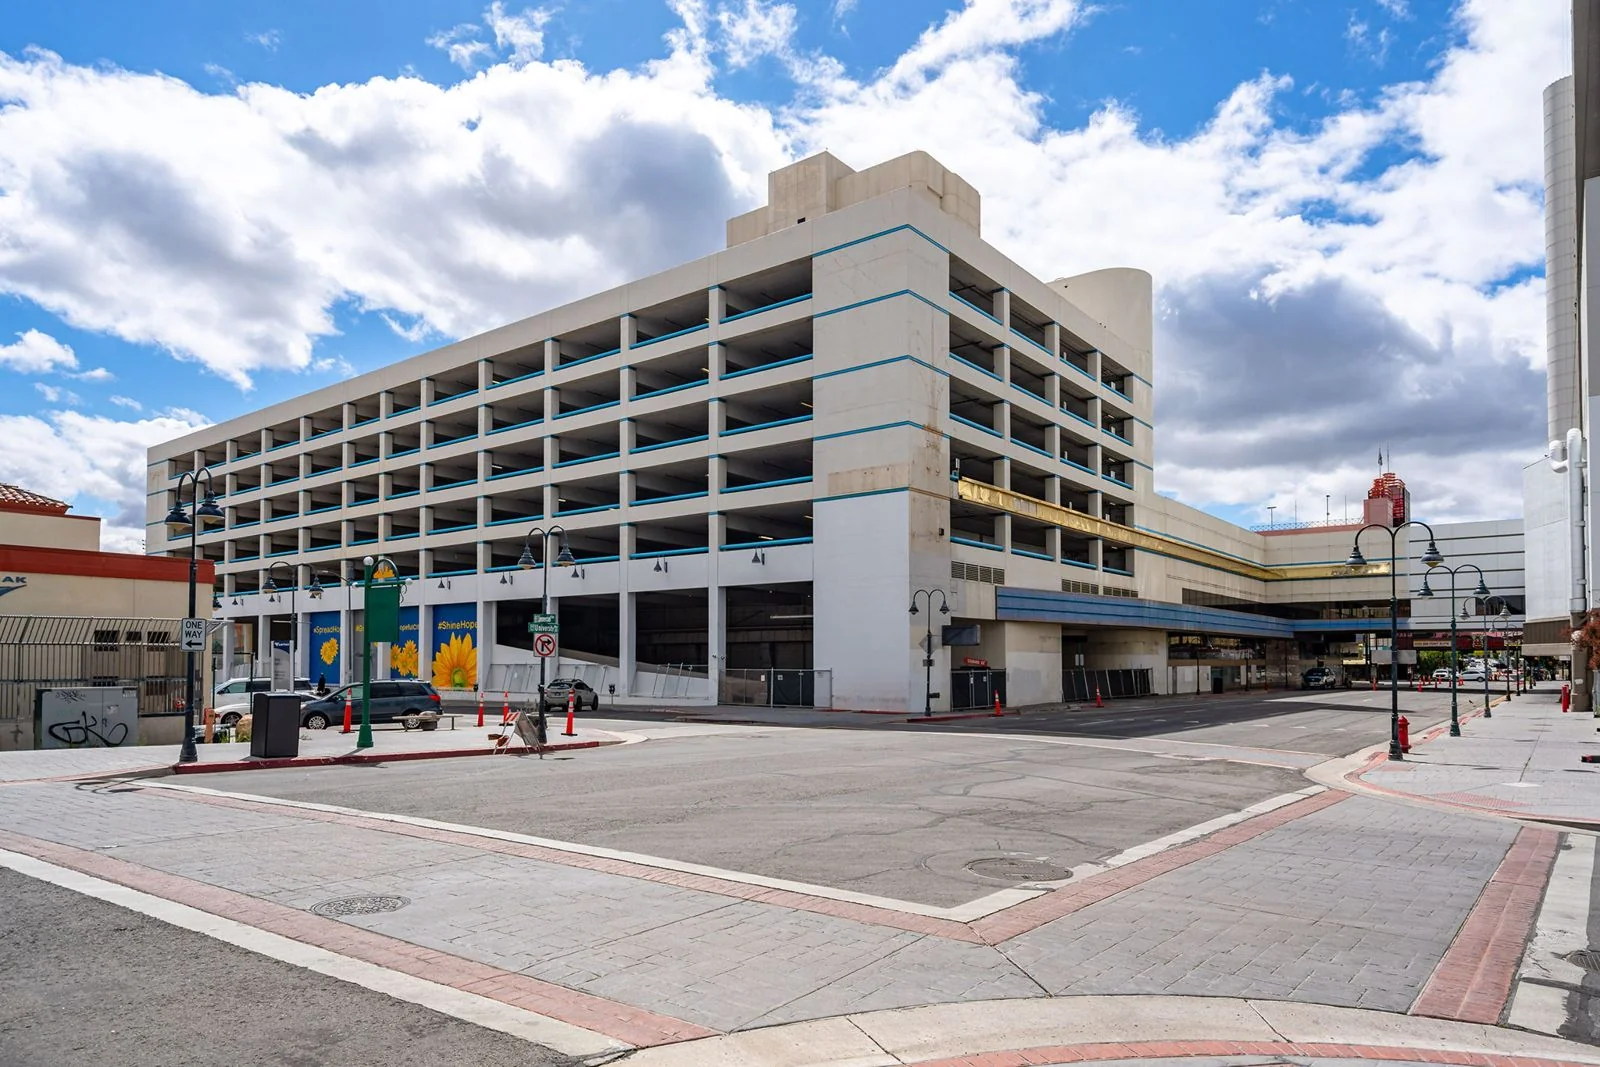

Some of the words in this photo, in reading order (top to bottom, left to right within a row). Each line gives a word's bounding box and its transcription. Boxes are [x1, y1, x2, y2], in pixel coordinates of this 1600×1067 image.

[185, 620, 203, 629] ONE
[437, 620, 479, 630] #ShineHope
[185, 630, 203, 639] WAY
